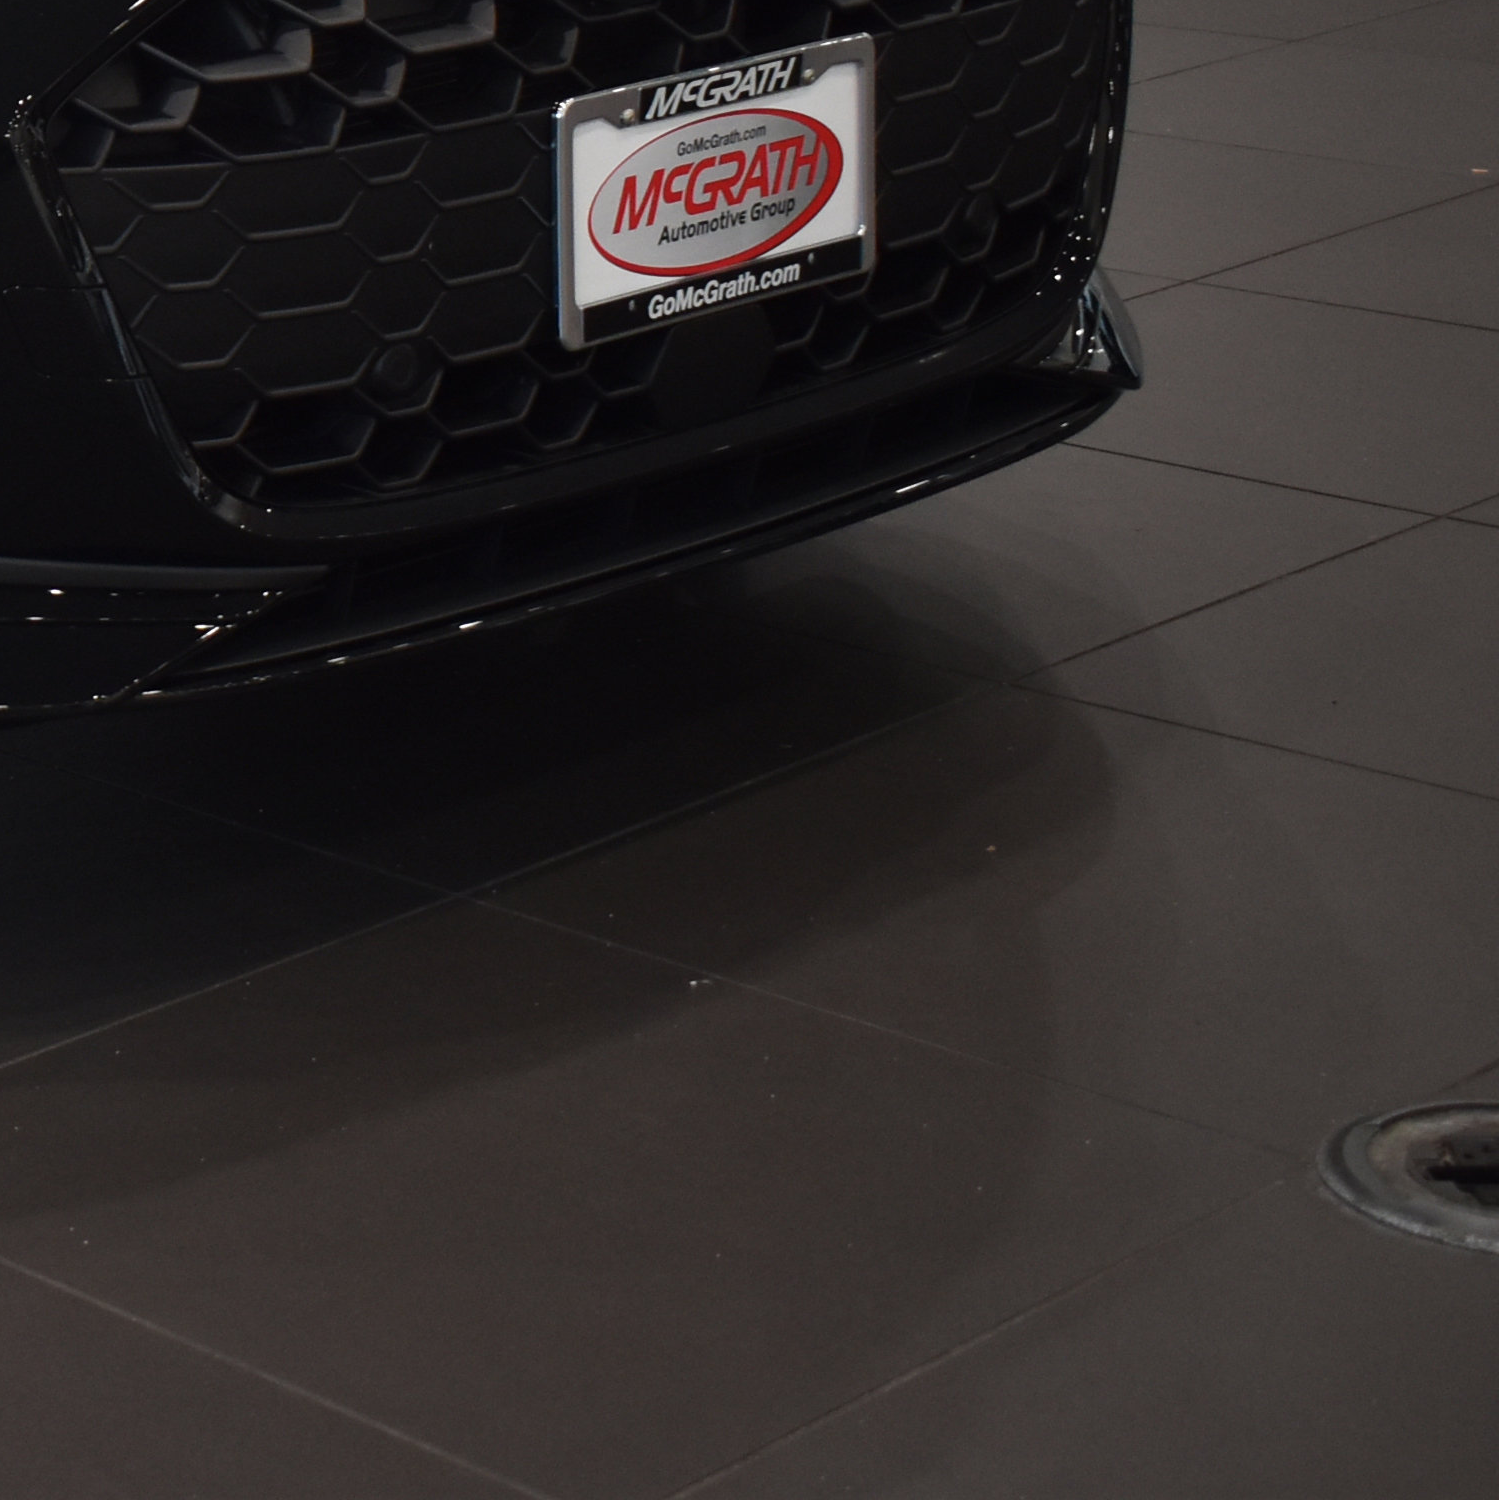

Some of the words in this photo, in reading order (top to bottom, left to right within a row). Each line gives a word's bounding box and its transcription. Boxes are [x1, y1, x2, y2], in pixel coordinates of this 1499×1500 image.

[677, 124, 767, 157] GoMcGrath.com
[658, 209, 747, 246] Automotive
[750, 196, 796, 228] Group
[648, 262, 801, 320] GoMcGrath.com
